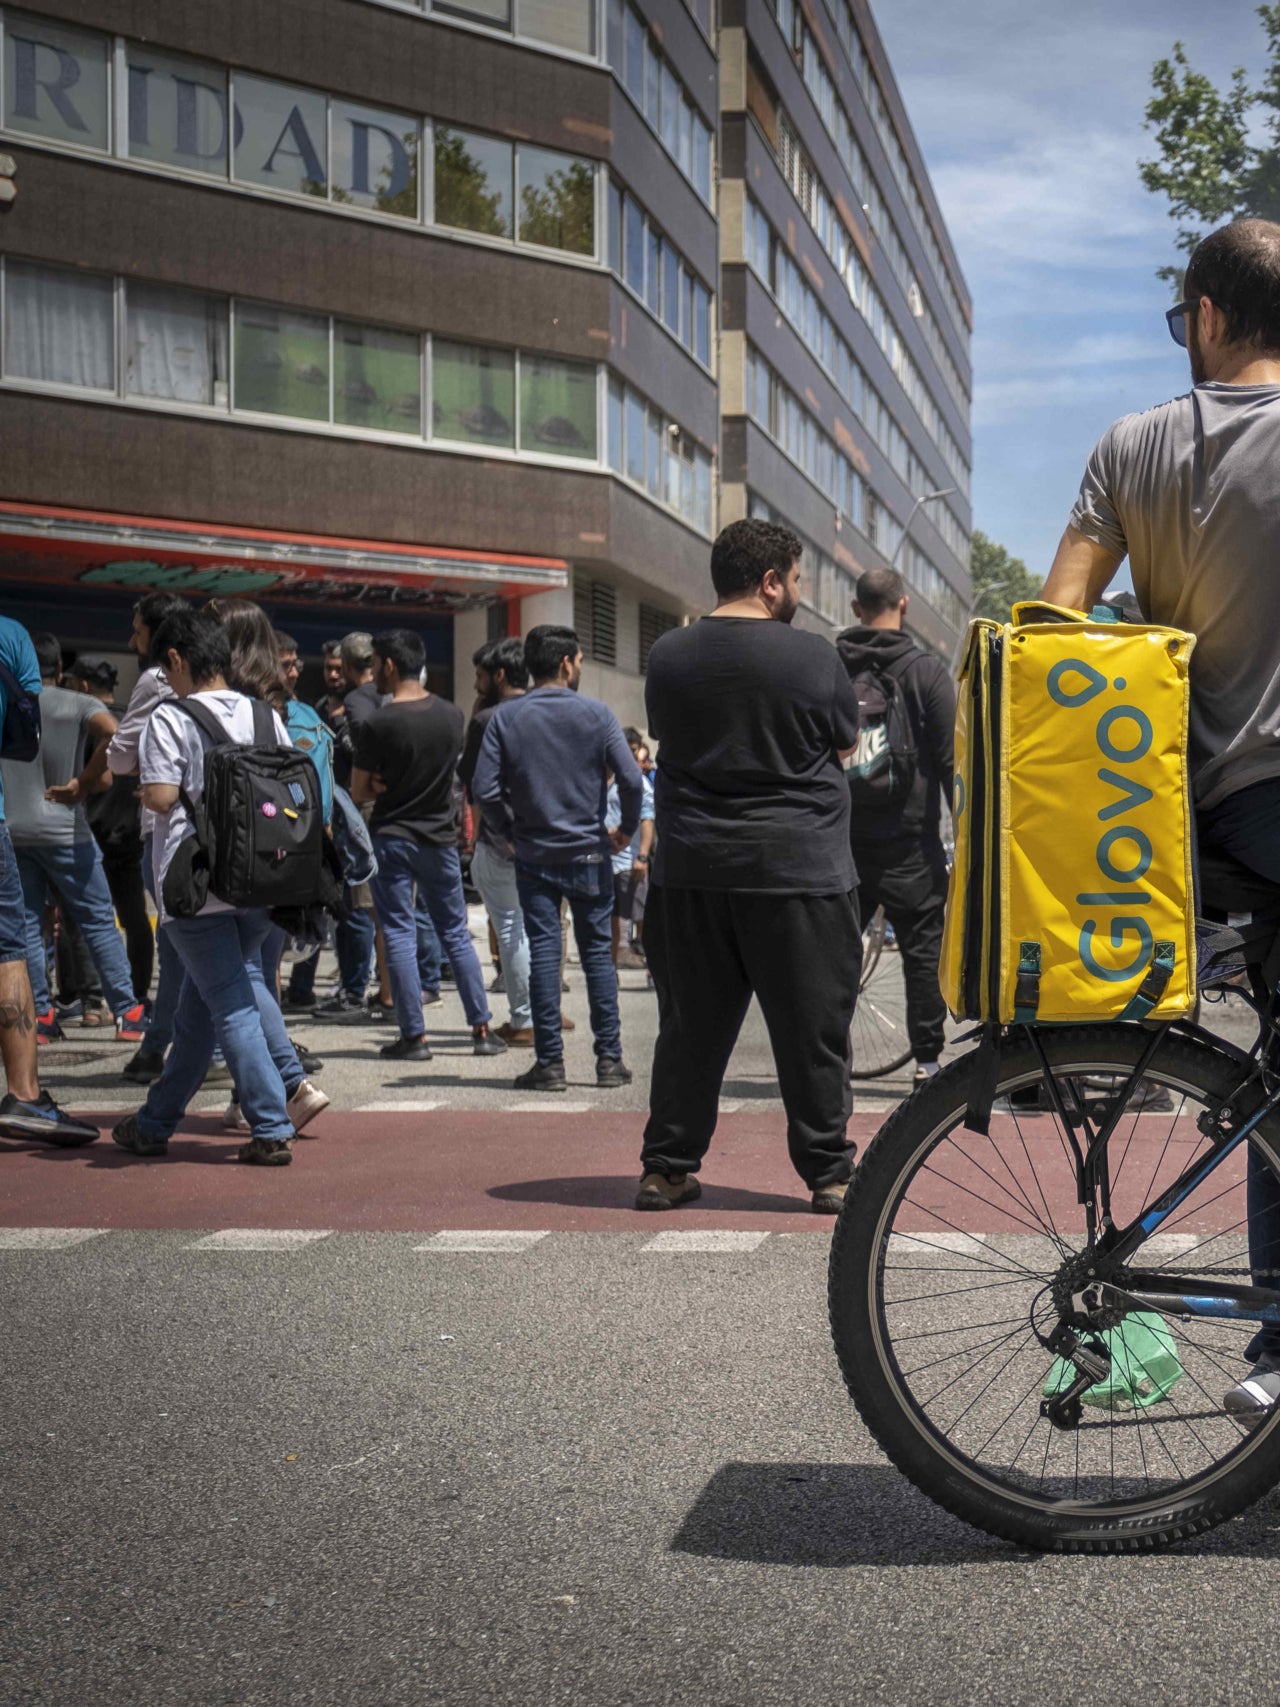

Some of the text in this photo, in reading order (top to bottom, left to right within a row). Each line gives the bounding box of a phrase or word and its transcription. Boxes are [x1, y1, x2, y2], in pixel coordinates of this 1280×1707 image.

[10, 34, 411, 199] RIDAD
[841, 722, 890, 771] IKE
[1076, 705, 1154, 982] Glovo
